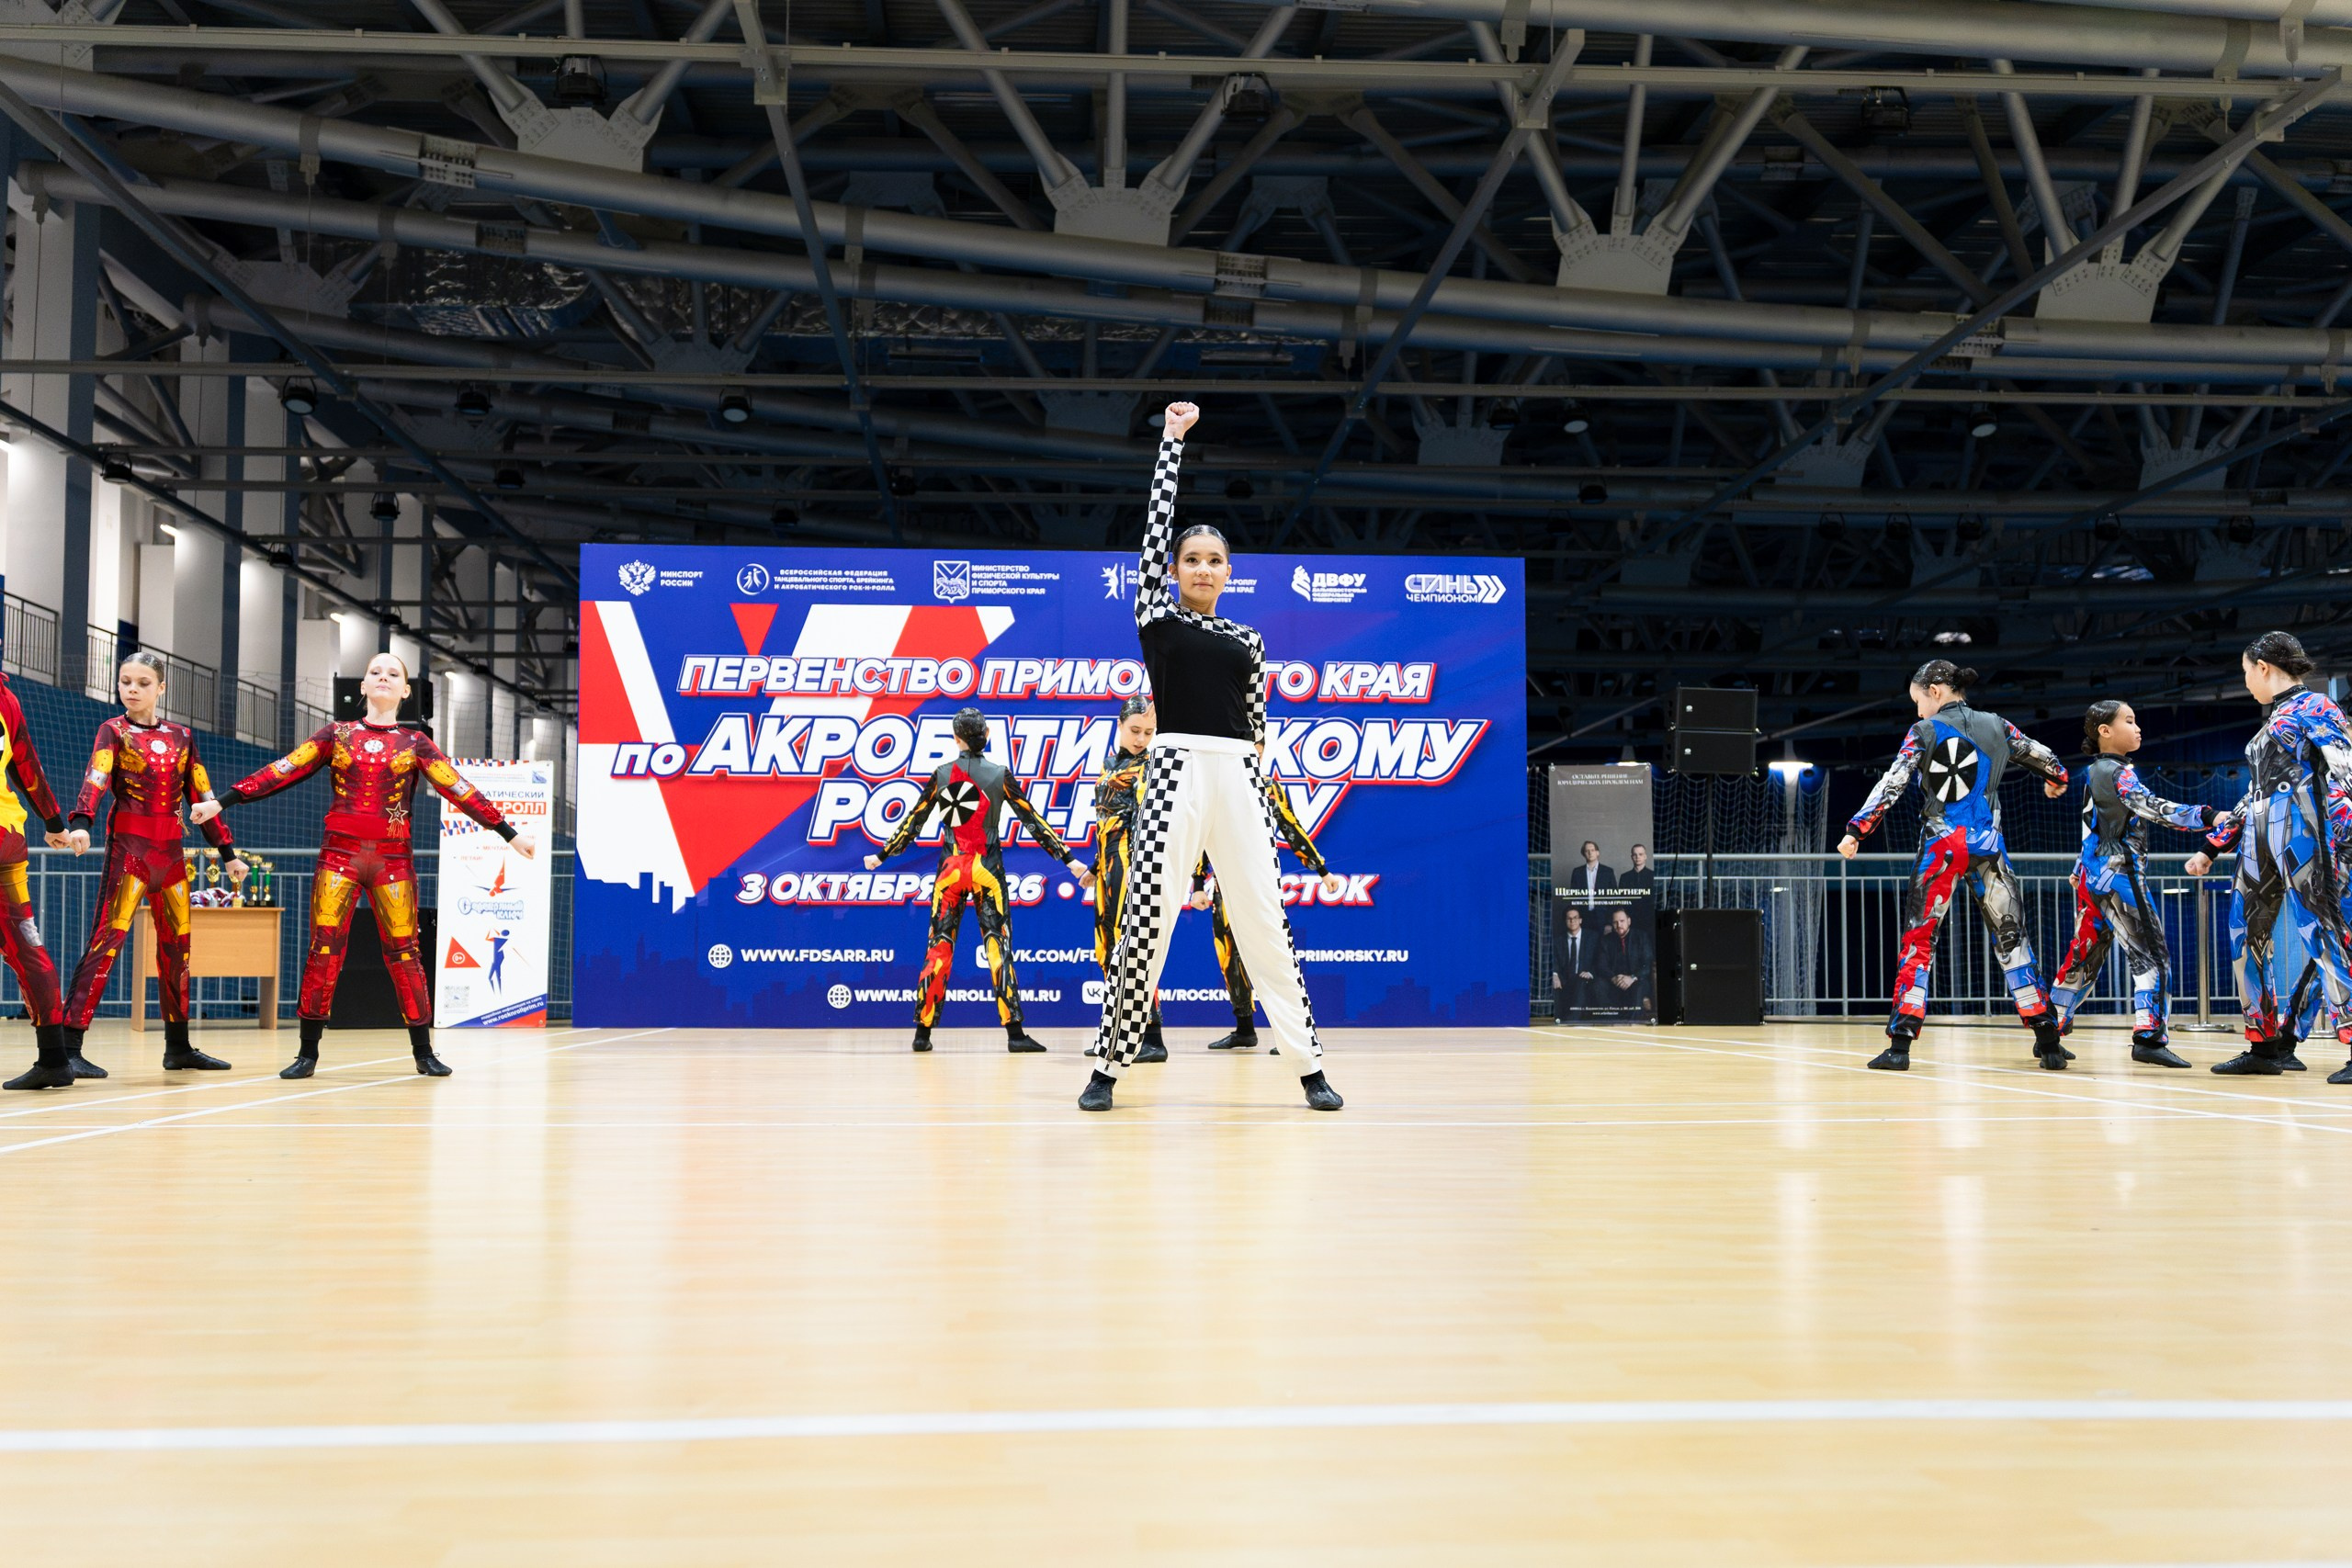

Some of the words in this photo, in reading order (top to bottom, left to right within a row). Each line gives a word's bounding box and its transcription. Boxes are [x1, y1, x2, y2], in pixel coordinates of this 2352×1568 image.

[843, 570, 888, 578] ФЕДЕРАЦИЯ
[971, 564, 1030, 572] МИНИСТЕРСТВО
[660, 570, 703, 579] МИНСПОРТ
[856, 576, 894, 584] БРЕЙКИНГА
[1311, 572, 1367, 588] ДВФУ
[660, 579, 694, 587] РОССИИ
[1404, 573, 1478, 594] СТАНЬ
[1405, 593, 1479, 604] ЧЕМПИОНОМ
[676, 654, 978, 698] ПЕРВЕНСТВО
[1317, 660, 1436, 703] КРАЯ
[735, 872, 767, 905] 3
[741, 948, 895, 964] WWW.FDSARR.RU
[1295, 949, 1409, 963] PRIMORSKY.RU
